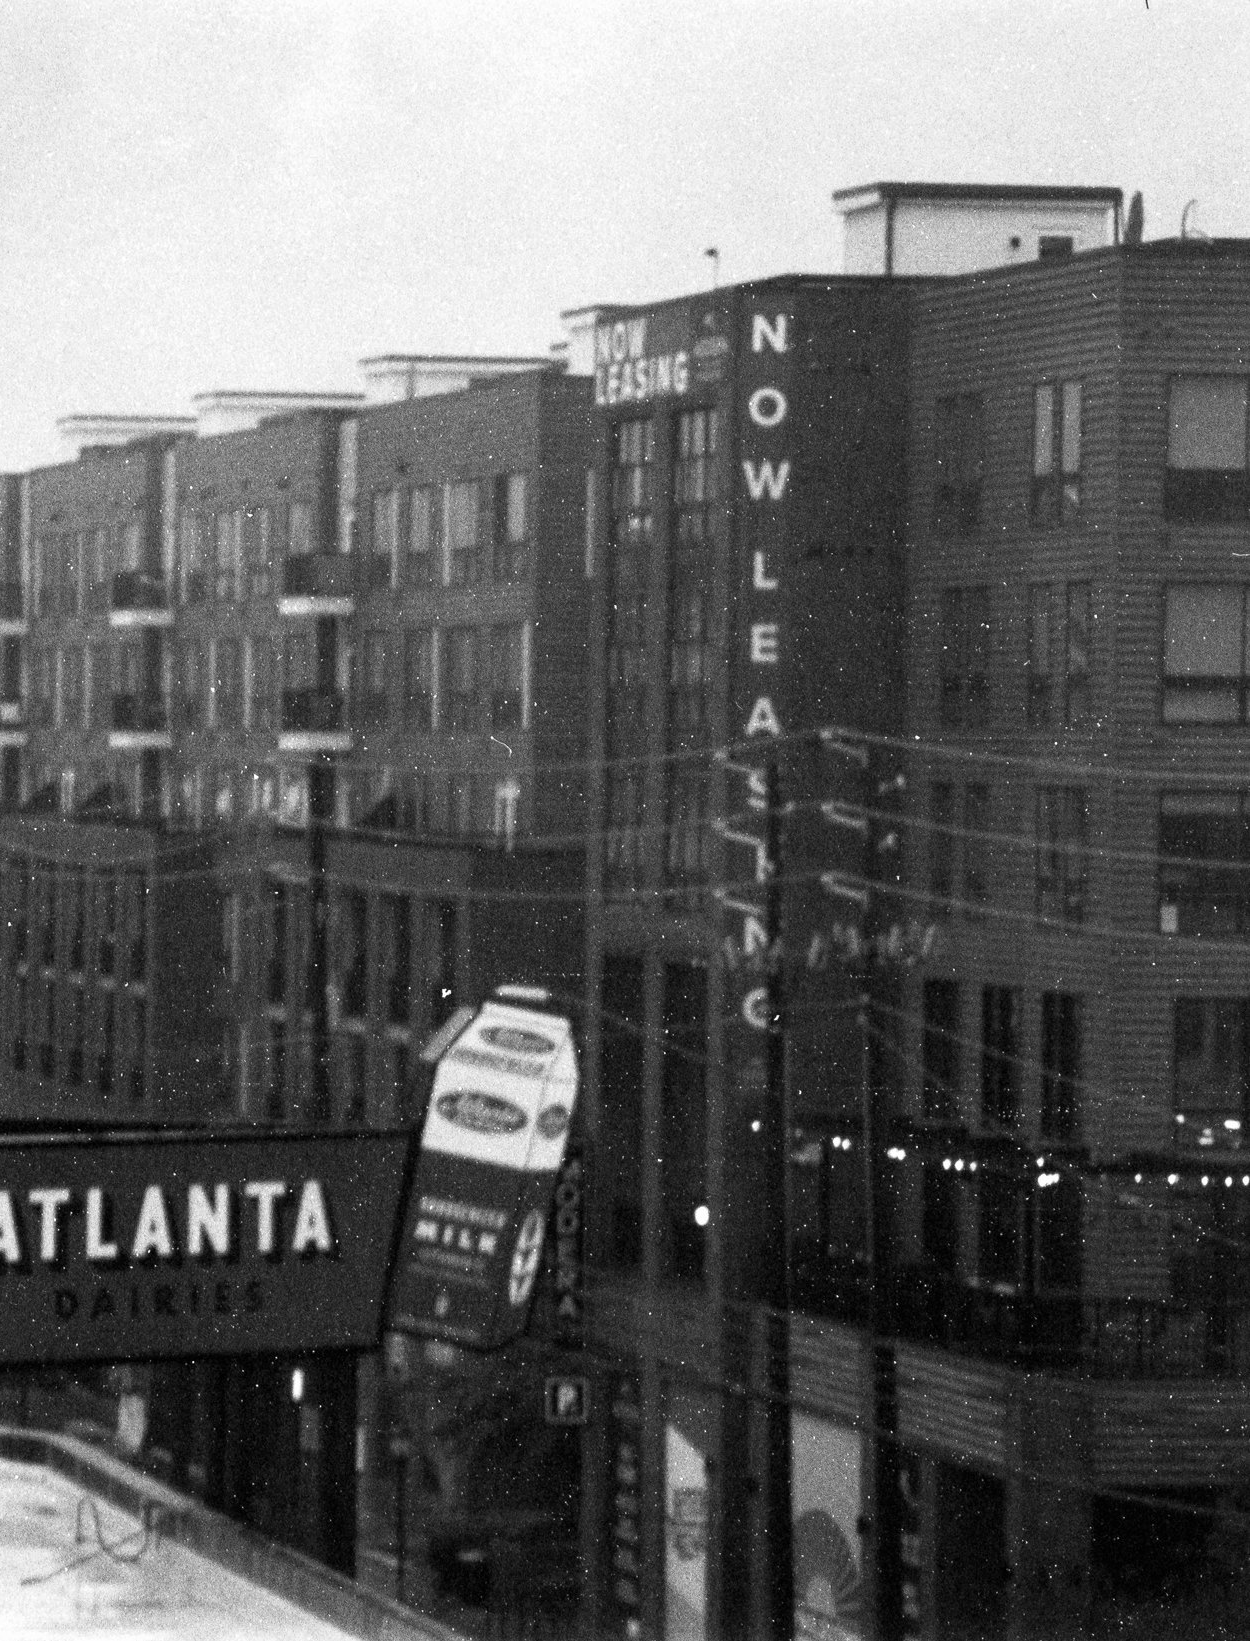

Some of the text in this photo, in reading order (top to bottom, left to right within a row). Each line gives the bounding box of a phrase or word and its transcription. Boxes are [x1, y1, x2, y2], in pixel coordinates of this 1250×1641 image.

[596, 316, 647, 365] NOW
[595, 349, 689, 406] LEASING
[743, 312, 790, 502] NOW
[414, 1219, 498, 1255] MILK
[53, 1280, 266, 1321] DAIRIES
